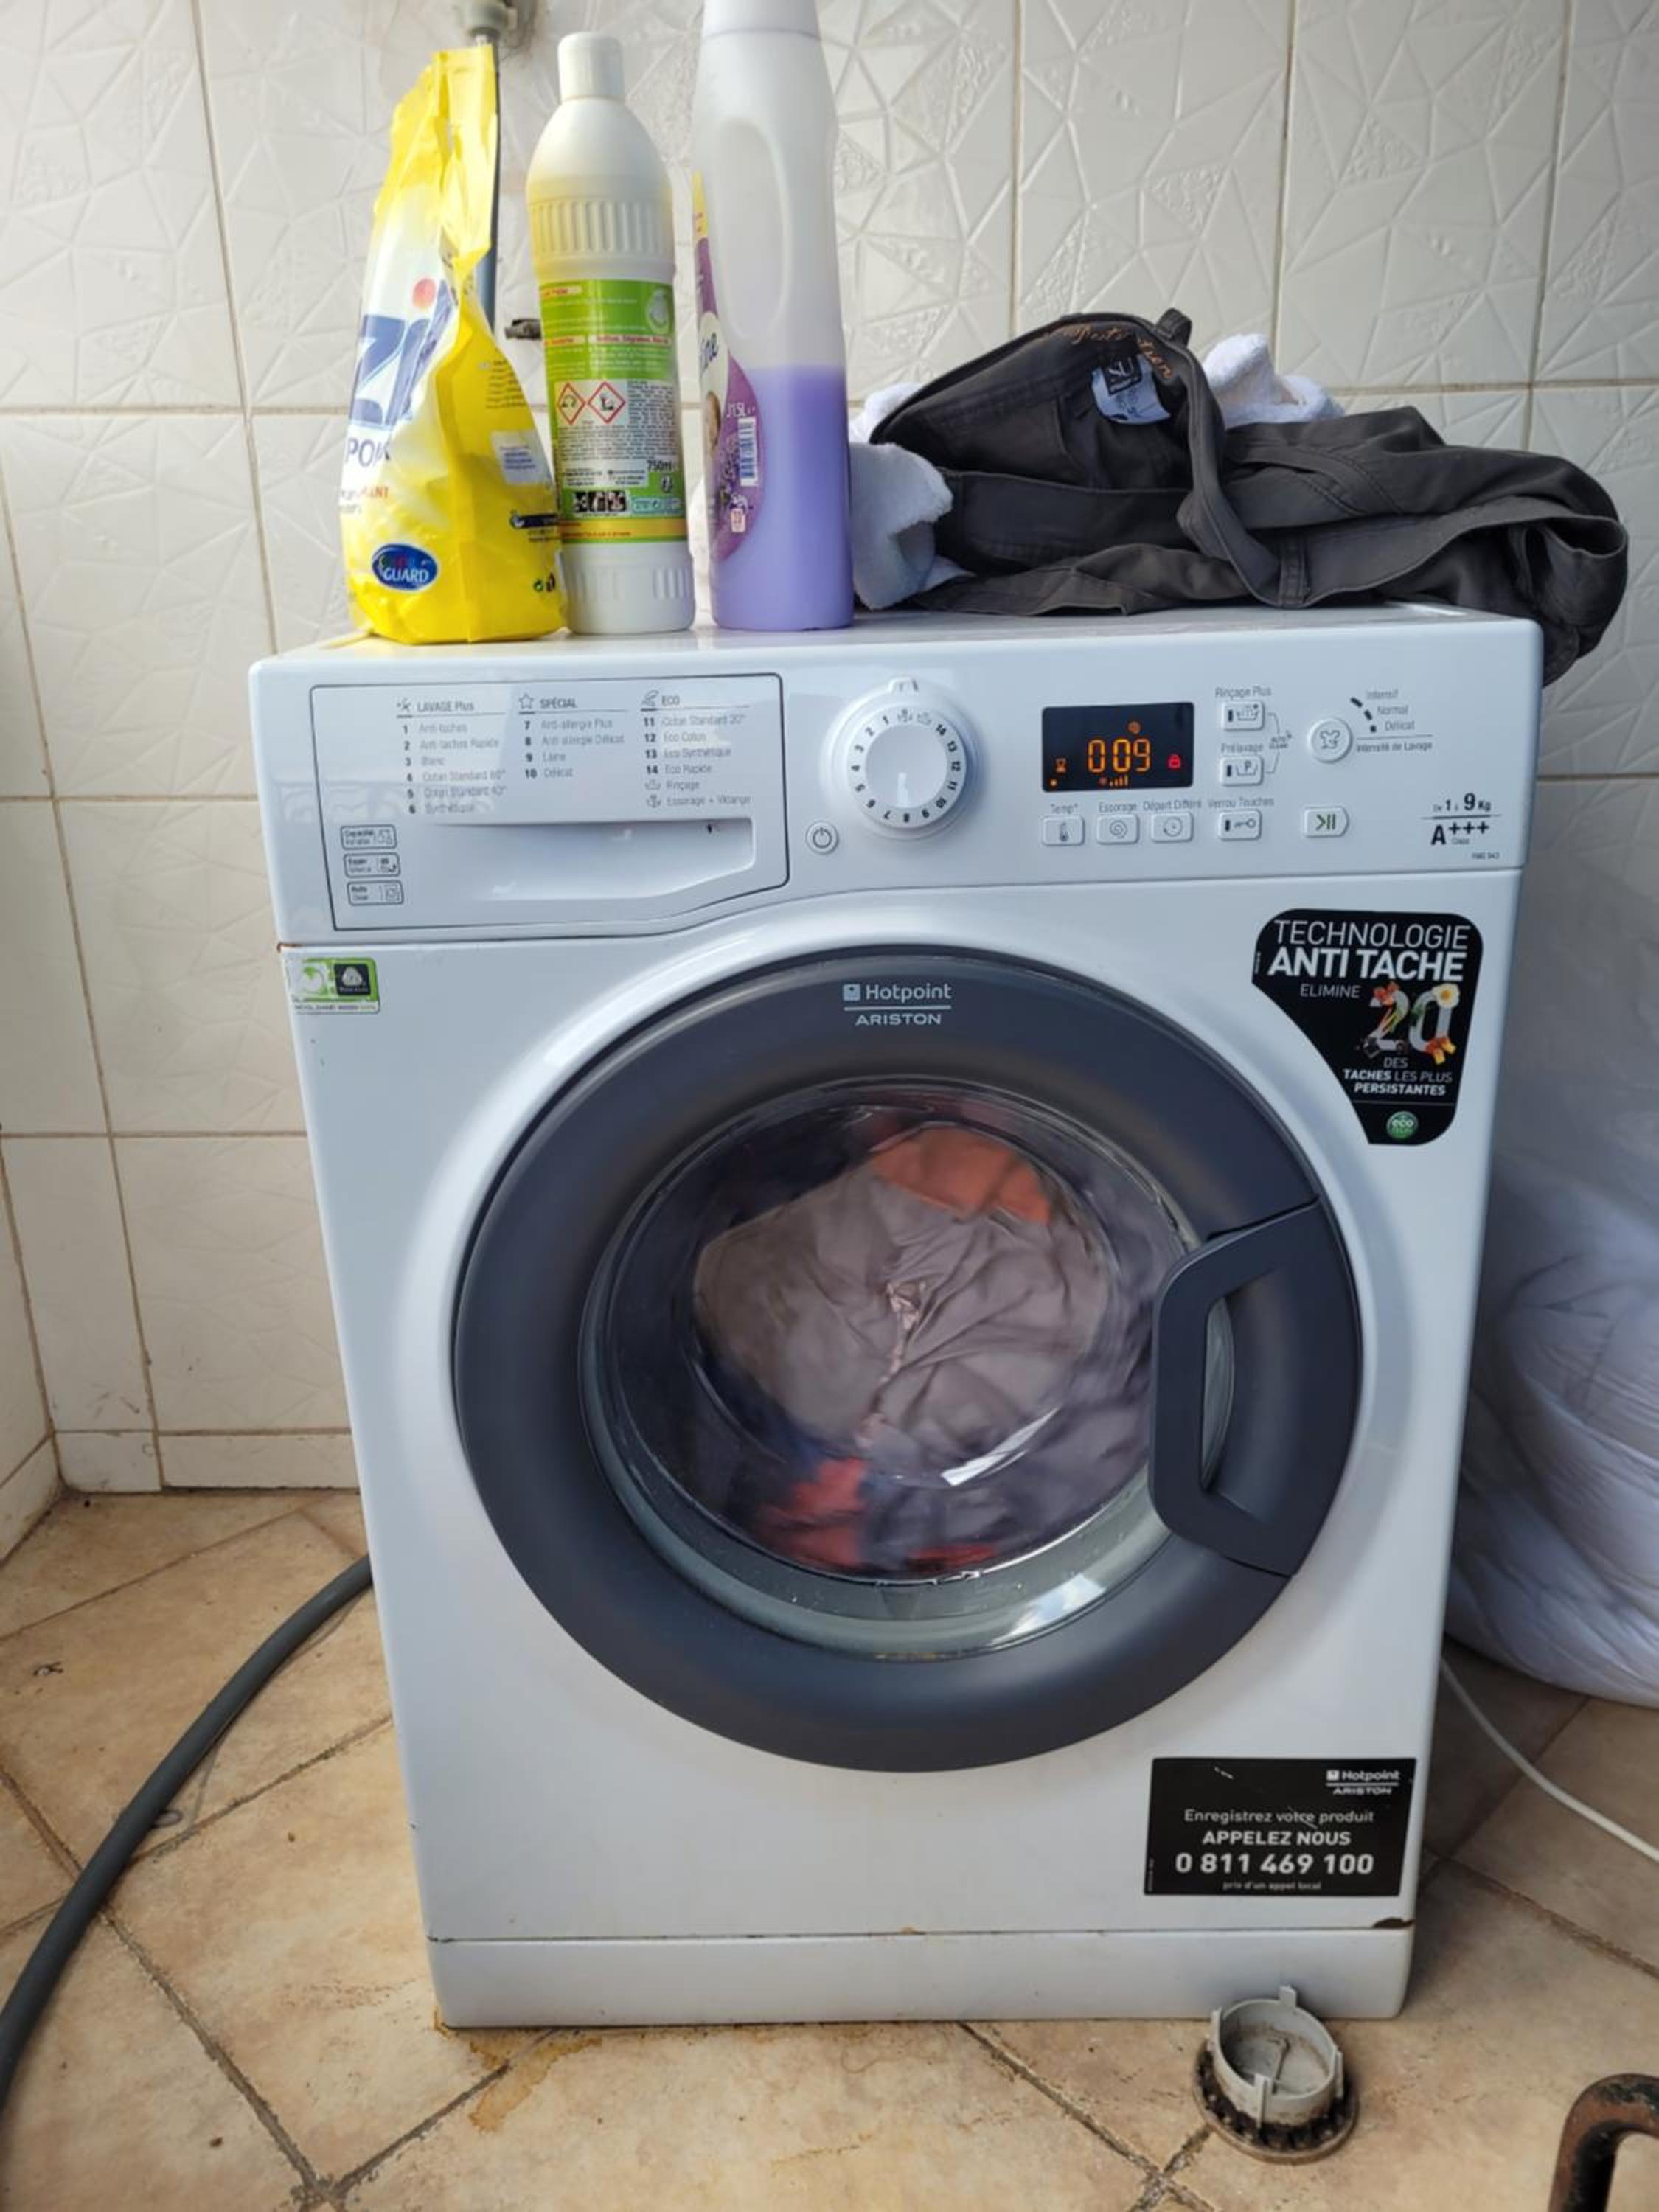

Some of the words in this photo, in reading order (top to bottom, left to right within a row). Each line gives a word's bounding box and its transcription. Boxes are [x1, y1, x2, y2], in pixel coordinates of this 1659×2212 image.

[383, 567, 429, 583] GUARD
[1215, 686, 1251, 700] Rinçage
[1253, 686, 1272, 697] Plus
[455, 700, 474, 712] Plus
[661, 695, 680, 706] ECO
[1377, 705, 1409, 715] Normal
[525, 720, 530, 730] 7
[644, 717, 655, 726] 11
[403, 725, 408, 734] 1
[644, 733, 655, 742] 12
[404, 740, 411, 751] 2
[1403, 742, 1433, 753] Lavage
[645, 749, 657, 759] 13
[406, 757, 411, 767] 3
[525, 768, 538, 779] 10
[647, 765, 658, 774] 14
[1099, 801, 1137, 813] Essorage
[1239, 796, 1275, 807] Touches
[1446, 799, 1451, 811] 1
[1464, 792, 1475, 811] 9
[1431, 820, 1489, 846] A+++
[1273, 919, 1471, 950] TECHNOLOGIE
[1267, 947, 1349, 978] ANTI
[1357, 949, 1467, 981] TACHE
[865, 983, 953, 1004] Hotpoint
[1300, 982, 1361, 999] ELIMINE
[855, 1013, 942, 1027] ARISTON
[1365, 982, 1460, 1059] 20
[1383, 1057, 1408, 1069] DES
[1343, 1068, 1392, 1082] TACHES
[1394, 1070, 1418, 1083] LES
[1419, 1071, 1453, 1083] PLUS
[1353, 1081, 1447, 1096] PERSISTANTES
[1341, 1770, 1400, 1783] Hotpoint
[1332, 1787, 1393, 1795] ARISTON
[1183, 1808, 1273, 1825] Enregistrez
[1276, 1810, 1316, 1823] votre
[1318, 1809, 1374, 1825] produit
[1202, 1830, 1292, 1846] APPELEZ
[1296, 1831, 1352, 1846] NOUS
[1175, 1852, 1192, 1874] 0
[1200, 1852, 1251, 1874] 811
[1259, 1853, 1314, 1874] 469
[1324, 1854, 1374, 1875] 100
[1222, 1880, 1242, 1891] prix
[1267, 1880, 1296, 1891] appel
[1298, 1880, 1322, 1890] local
